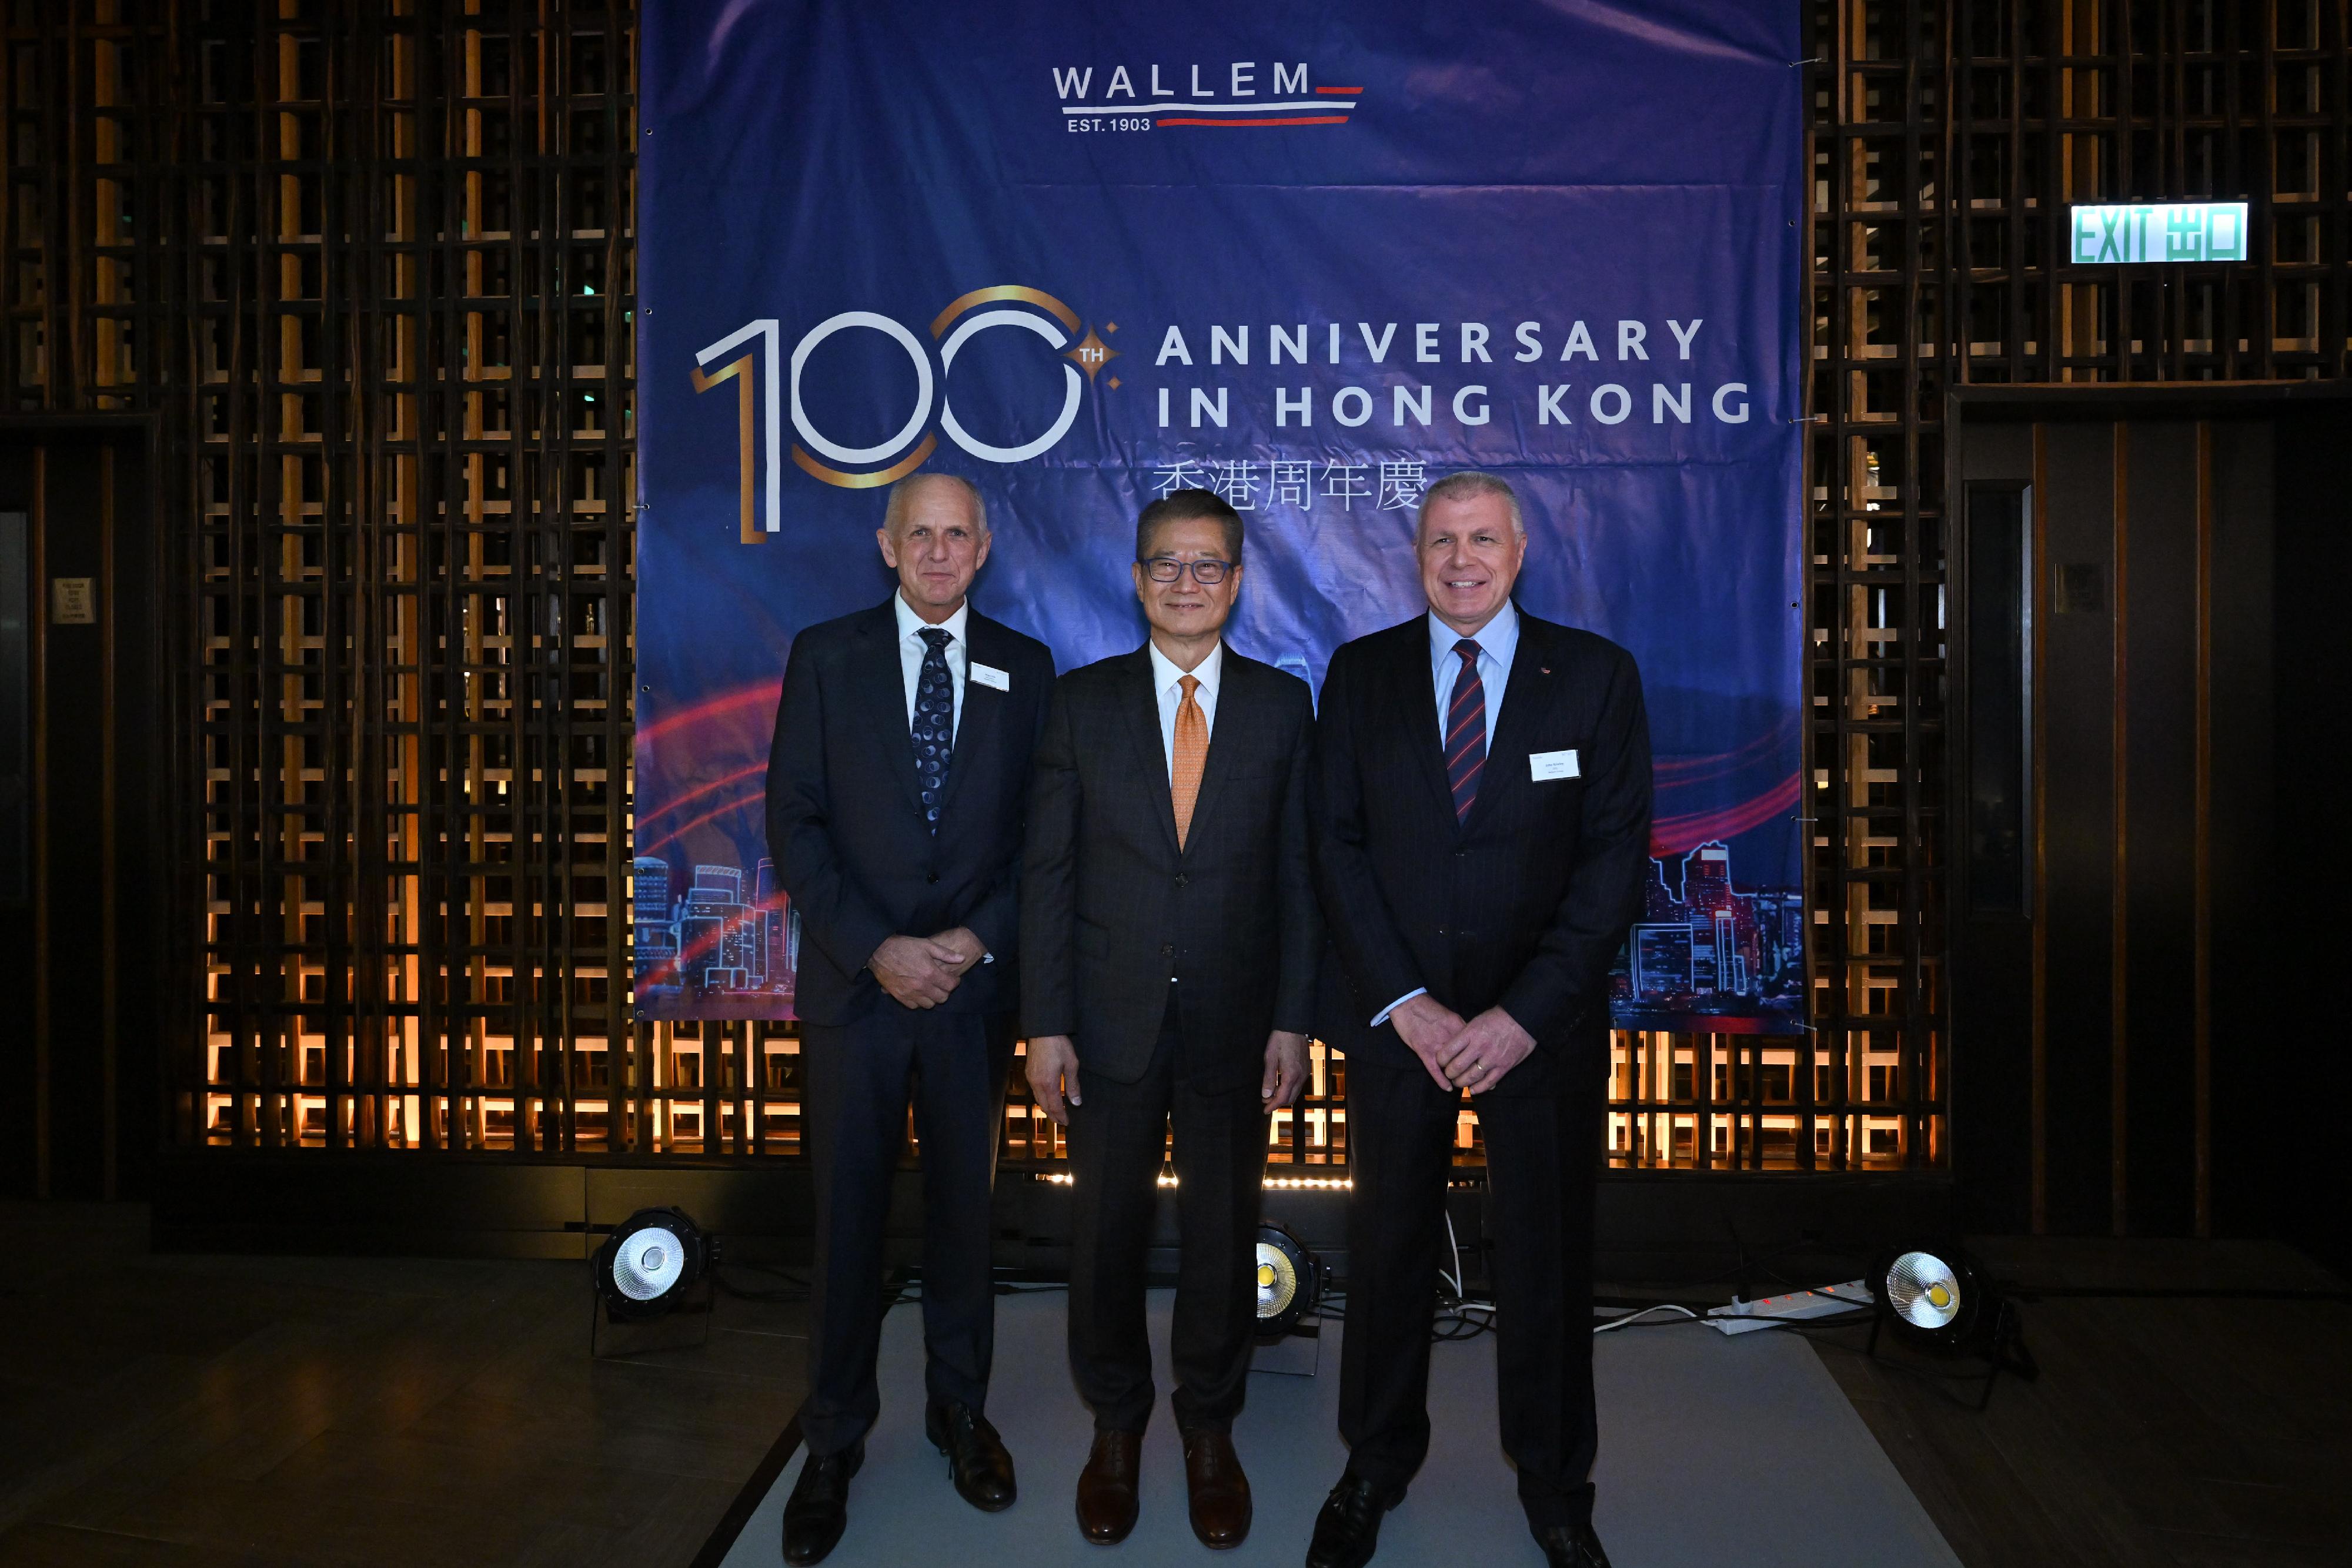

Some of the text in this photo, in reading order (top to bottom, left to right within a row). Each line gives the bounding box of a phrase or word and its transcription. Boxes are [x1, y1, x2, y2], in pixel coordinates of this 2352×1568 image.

[1053, 62, 1308, 99] WALLEM
[2075, 208, 2153, 263] EXIT
[2166, 206, 2241, 262] 出口
[1079, 347, 1104, 362] TH
[1155, 319, 1703, 366] ANNIVERSARY
[1158, 382, 1750, 427] IN HONG KONG
[1152, 457, 1428, 511] 香港周年慶
